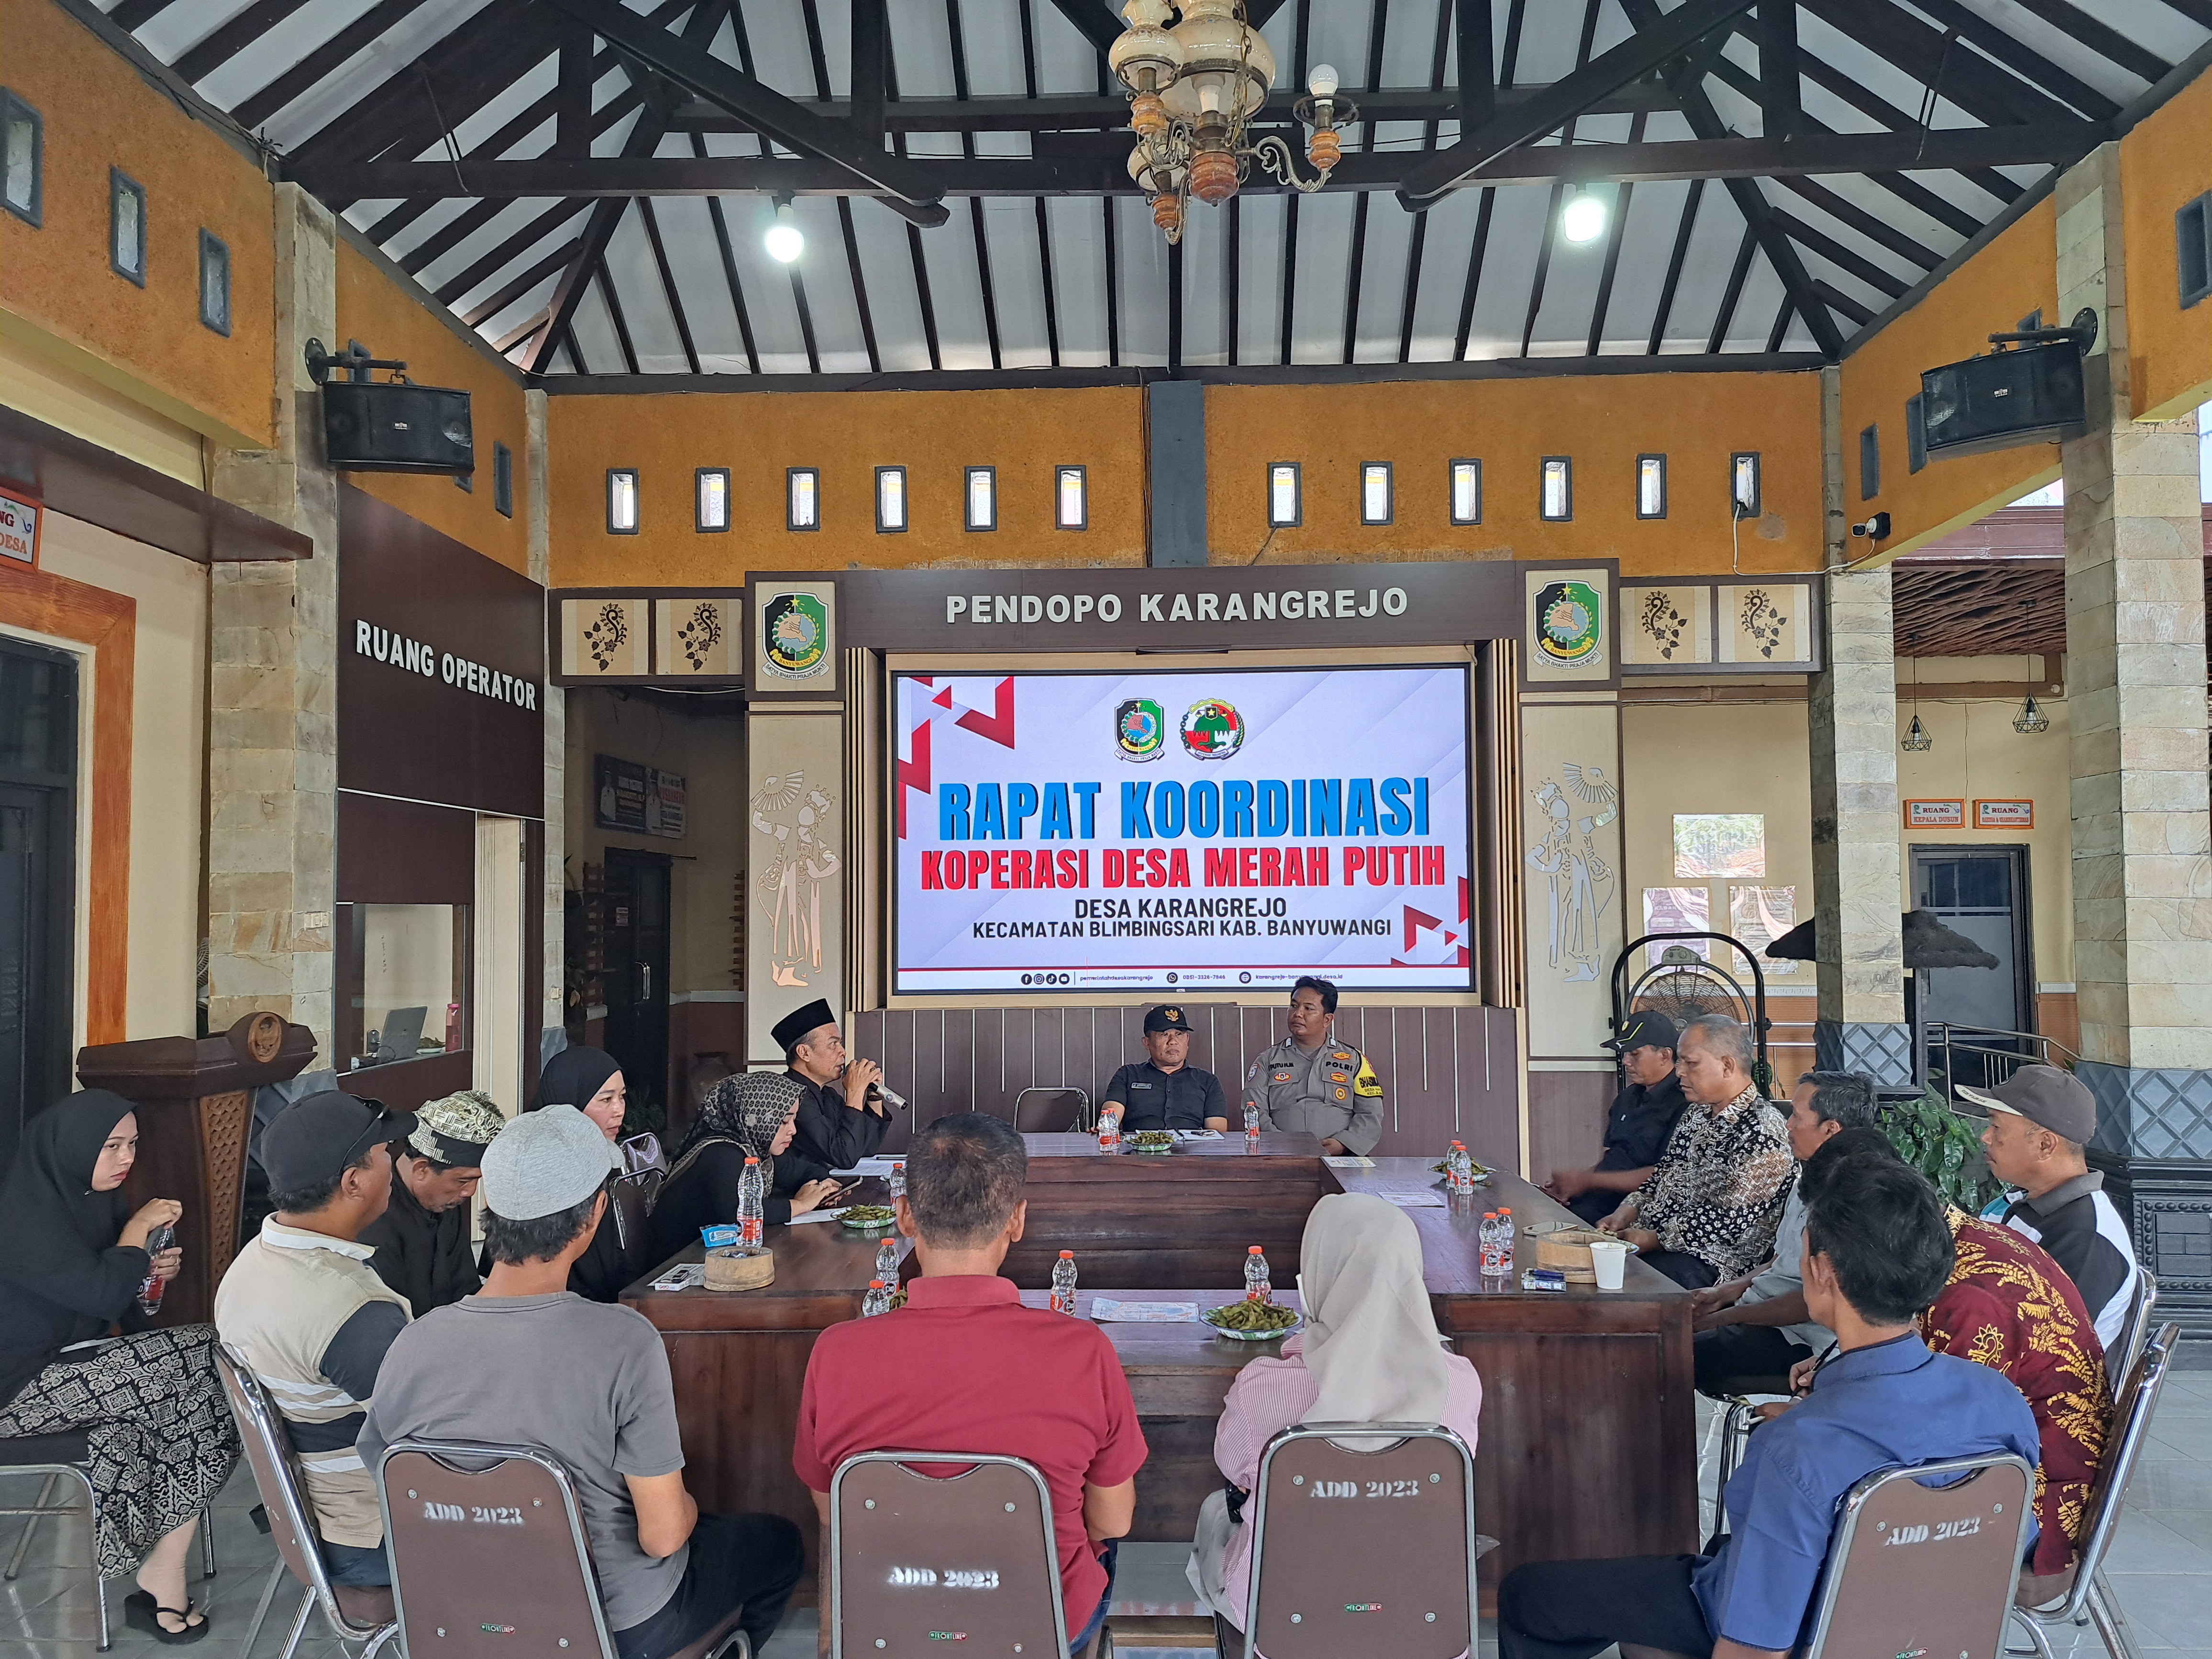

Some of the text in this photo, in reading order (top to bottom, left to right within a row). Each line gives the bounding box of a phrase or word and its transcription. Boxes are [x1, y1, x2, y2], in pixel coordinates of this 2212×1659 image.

[947, 587, 1407, 623] PENDOPO KARANGREJO
[778, 658, 813, 666] BANYUWANGI
[1537, 653, 1550, 664] SATYA
[1569, 660, 1585, 668] PRAJA
[1585, 652, 1599, 664] MUKTI
[1550, 647, 1585, 656] BANYUWANGI
[356, 619, 536, 711] RUANG OPERATOR
[765, 664, 779, 675] SATYA
[797, 671, 813, 679] PRAJA
[812, 664, 826, 675] MUKTI
[939, 777, 1429, 841] RAPAT KOORDINASI
[921, 845, 1445, 890] KOPERASI DESA MERAH PUTIH
[1075, 897, 1286, 918] DESA KARANGREJO
[973, 919, 1391, 938] KECAMATAN BLIMBINGSARI KAB. BANYUWANGI
[1326, 1061, 1354, 1072] POLRI
[1311, 1480, 1419, 1498] ADD 2023
[424, 1502, 524, 1525] ADD 2023
[1885, 1517, 1981, 1546] ADD 2023
[886, 1566, 1000, 1590] ADD 2023
